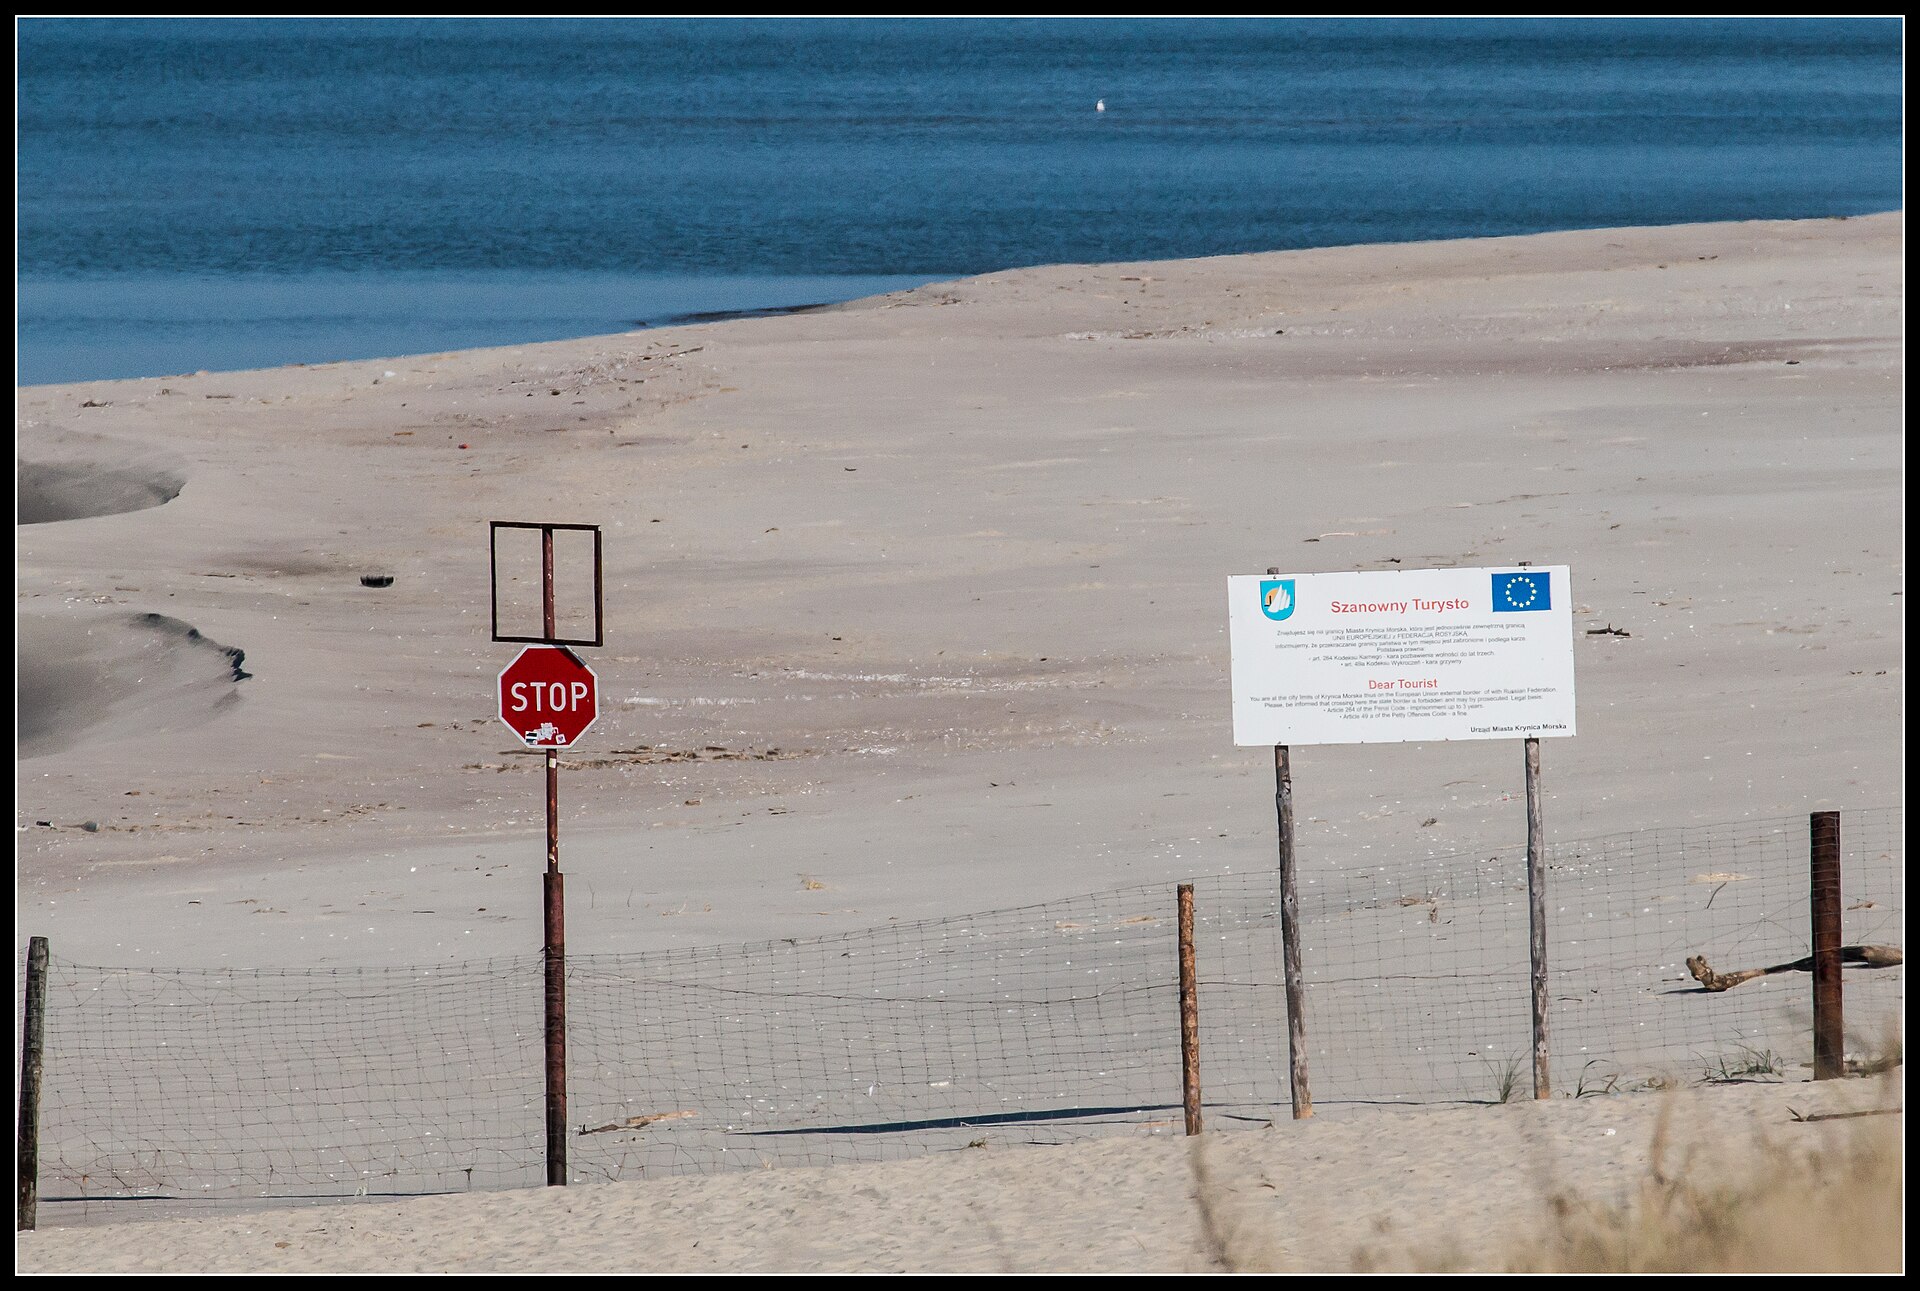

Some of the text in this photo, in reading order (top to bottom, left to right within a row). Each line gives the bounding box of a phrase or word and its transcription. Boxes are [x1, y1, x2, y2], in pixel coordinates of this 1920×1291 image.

[1331, 598, 1470, 614] Szanowny Turysto
[1369, 678, 1438, 690] Dear Tourist
[512, 682, 587, 711] STOP
